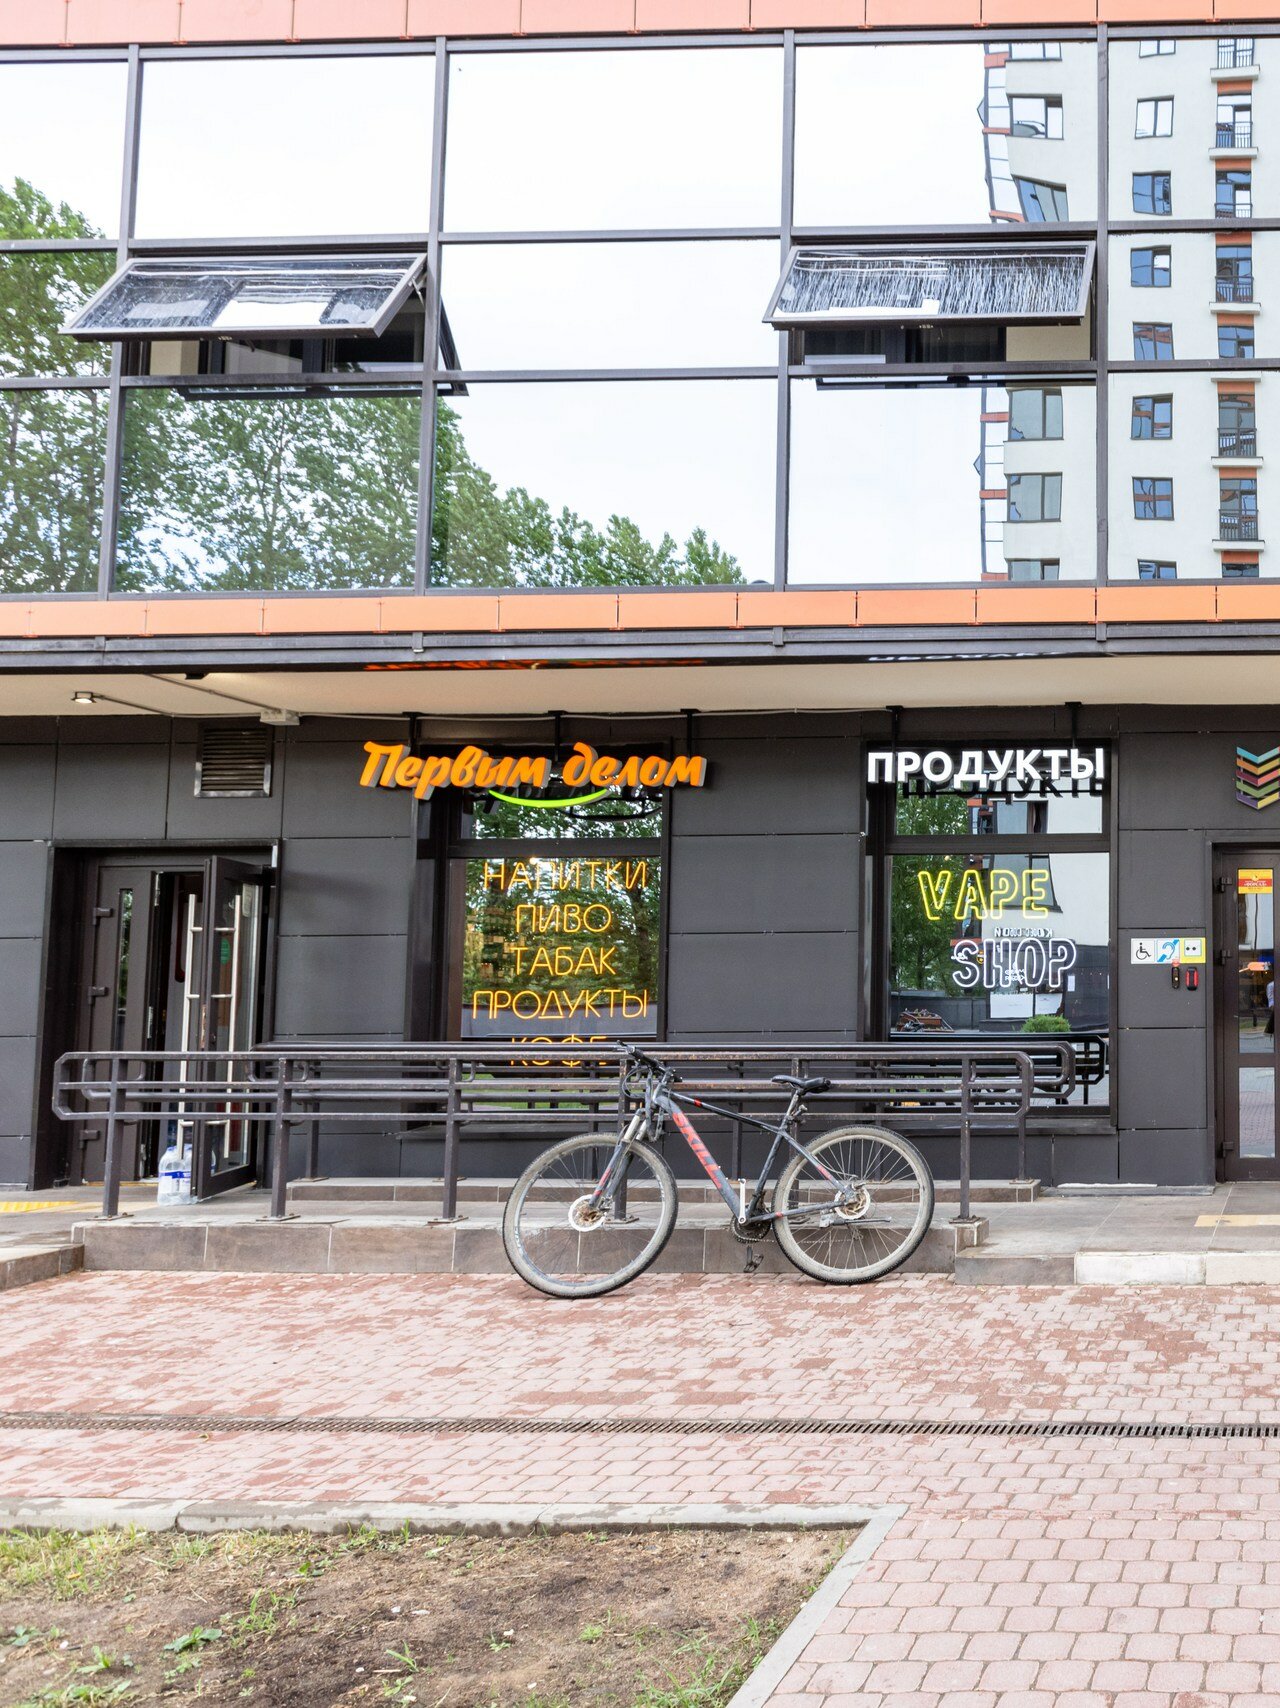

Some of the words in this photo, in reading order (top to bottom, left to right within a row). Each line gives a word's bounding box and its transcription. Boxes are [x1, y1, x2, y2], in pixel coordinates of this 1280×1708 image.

[359, 741, 552, 800] Первым
[563, 741, 707, 787] делом
[866, 747, 1106, 789] ПРОДУКТЫ
[483, 861, 648, 891] НАПИТКИ
[917, 869, 1050, 921] VAPE
[516, 903, 612, 934] ПИВО
[510, 946, 616, 976] ТАБАК
[952, 937, 1077, 989] SHOP
[472, 988, 648, 1020] ПРОДУКТЫ
[672, 1112, 723, 1190] SKILL
